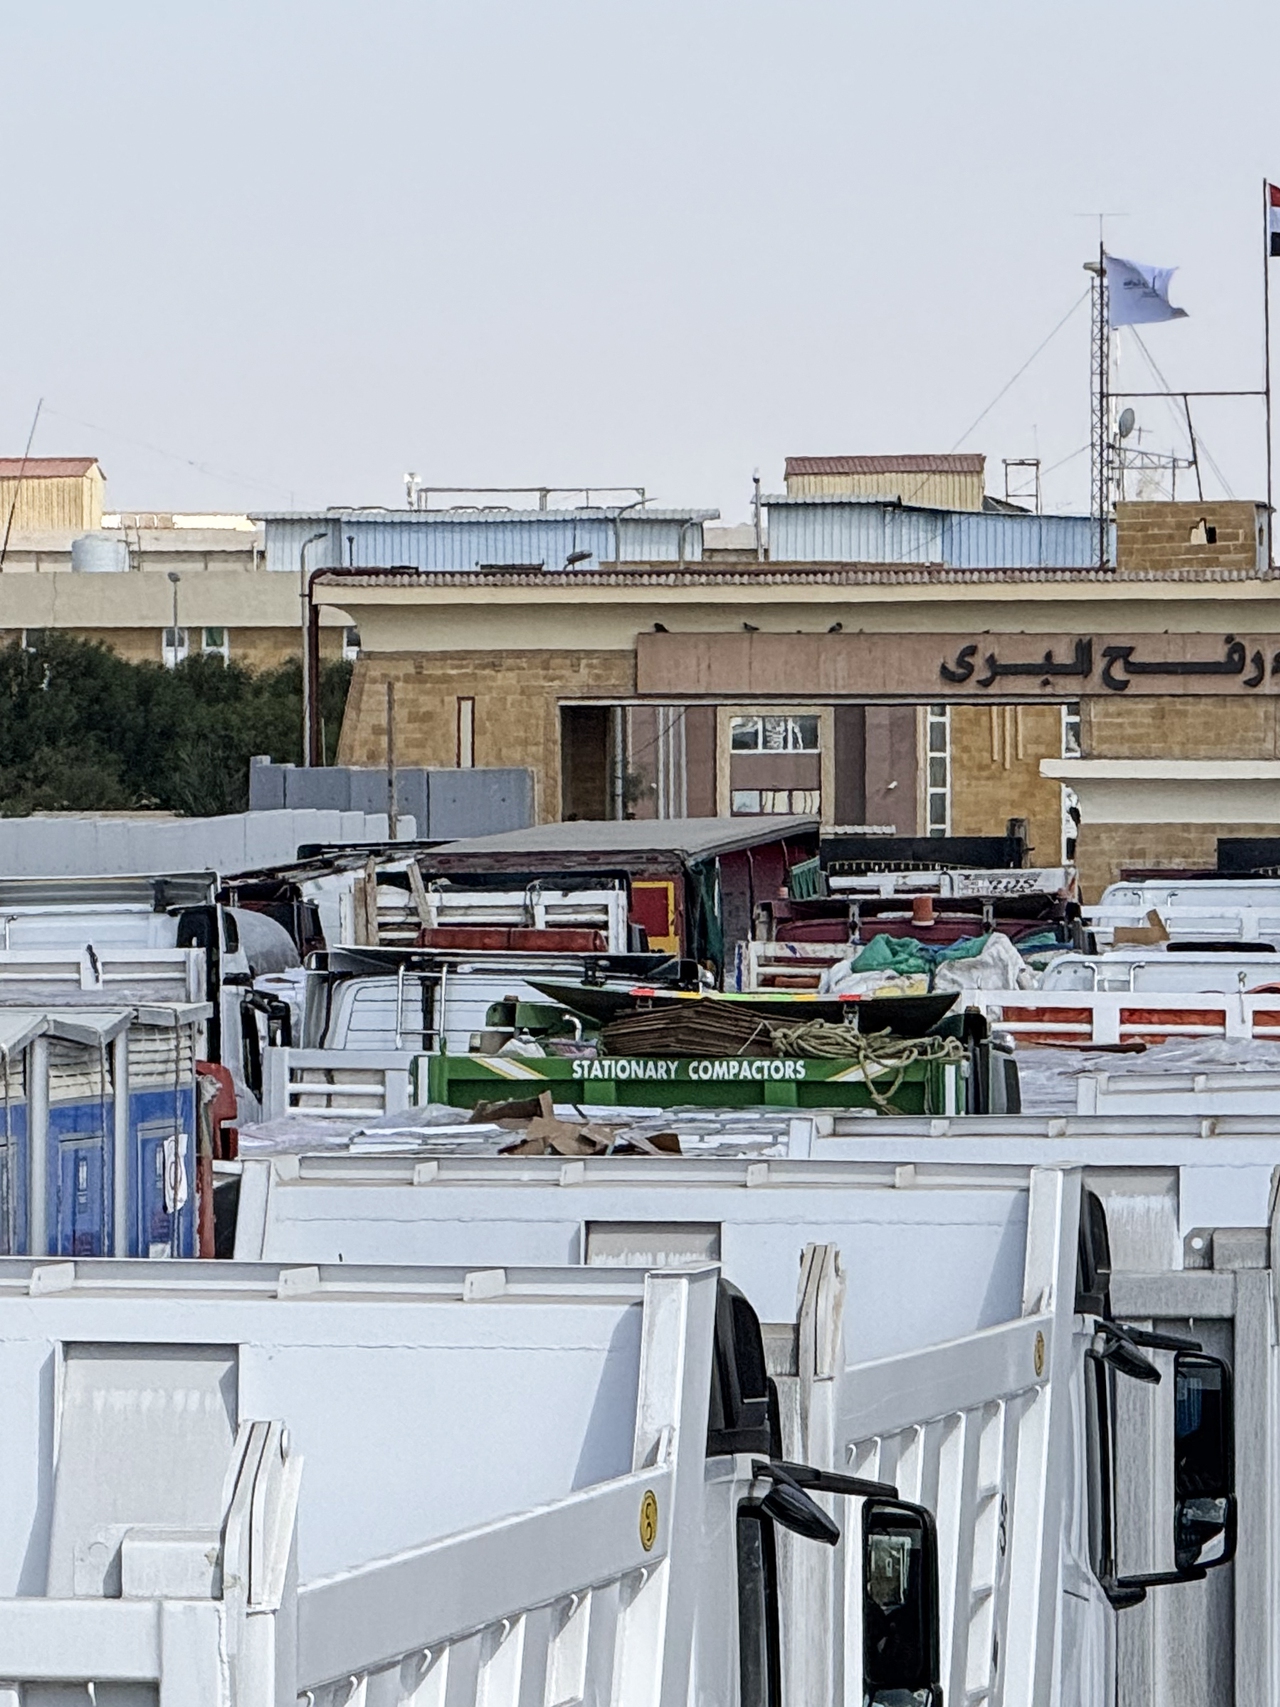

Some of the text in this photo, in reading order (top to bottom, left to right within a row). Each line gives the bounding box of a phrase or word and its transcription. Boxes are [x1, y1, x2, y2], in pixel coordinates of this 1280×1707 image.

[1101, 634, 1265, 691] رفح
[571, 1059, 806, 1080] STATIONARY COMPACTORS
